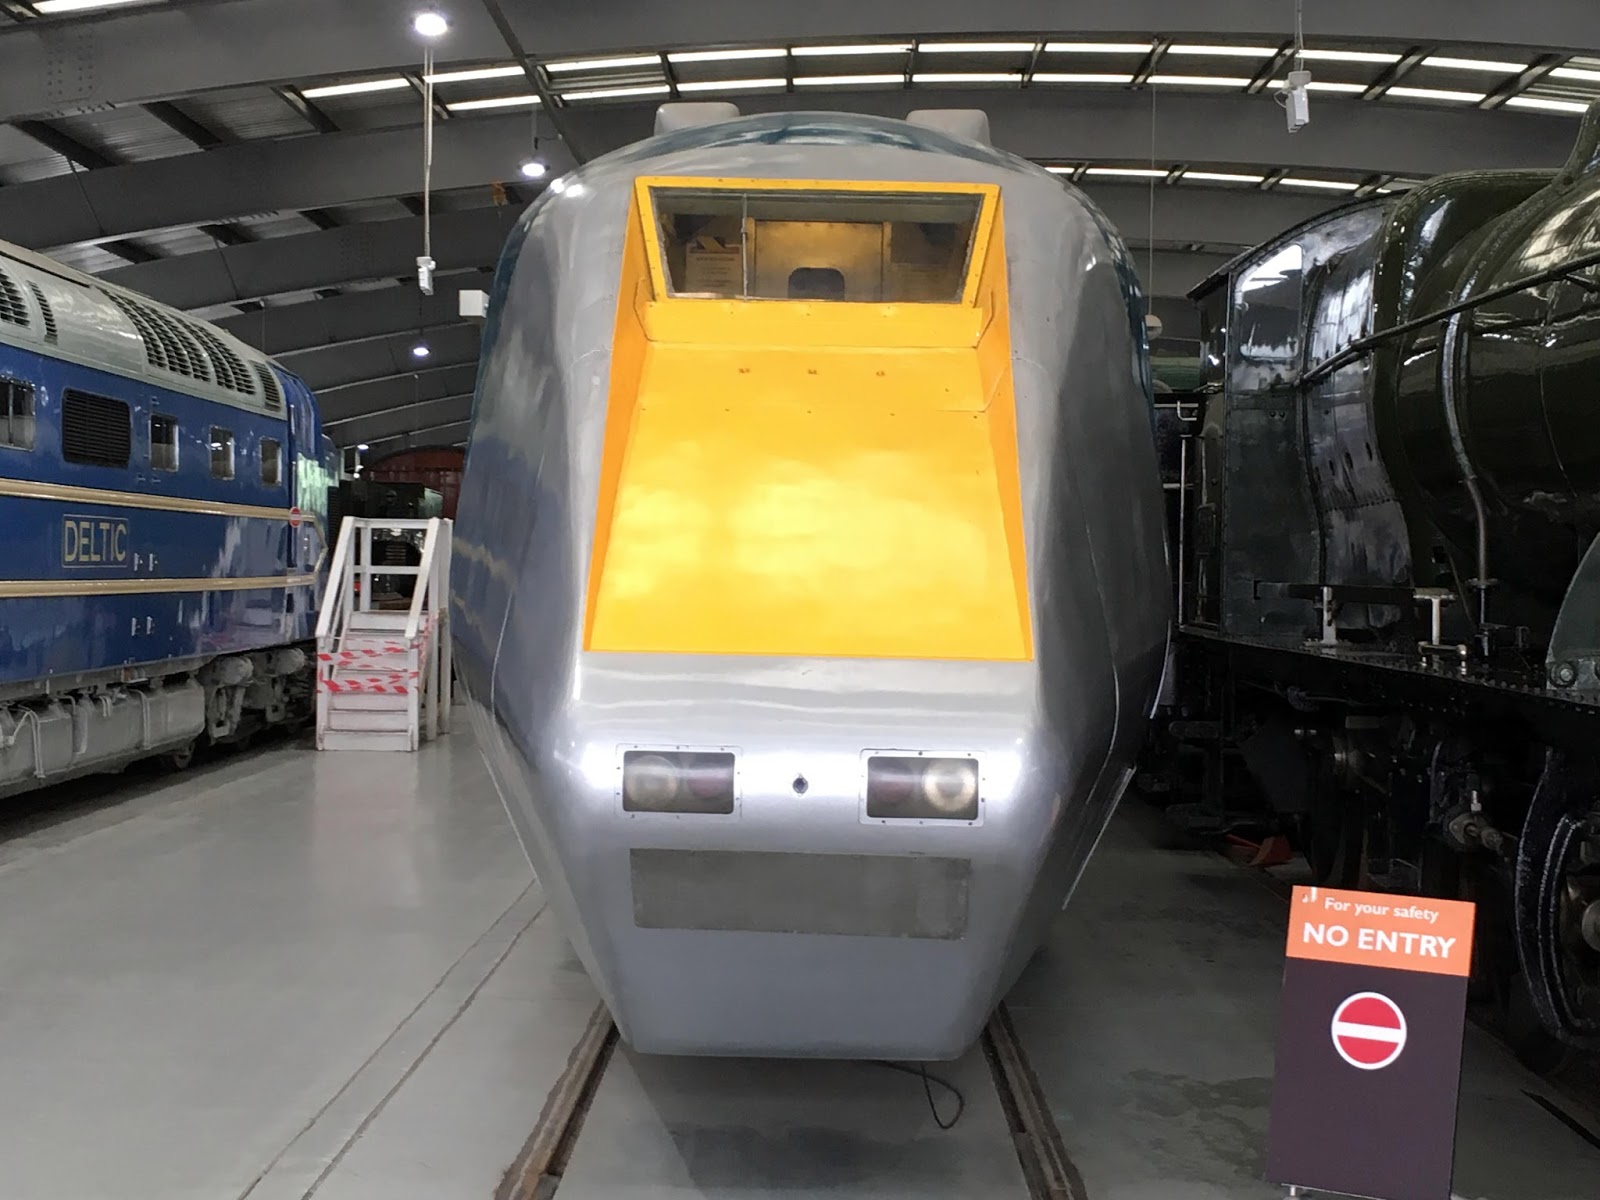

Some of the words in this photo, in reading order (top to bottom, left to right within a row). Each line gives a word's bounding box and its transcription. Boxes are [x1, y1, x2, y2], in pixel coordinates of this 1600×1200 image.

[64, 520, 127, 562] DELTIC
[1324, 896, 1351, 911] For
[1354, 903, 1389, 916] your
[1393, 905, 1439, 924] safety
[1303, 922, 1349, 947] NO
[1358, 928, 1456, 959] ENTRY
